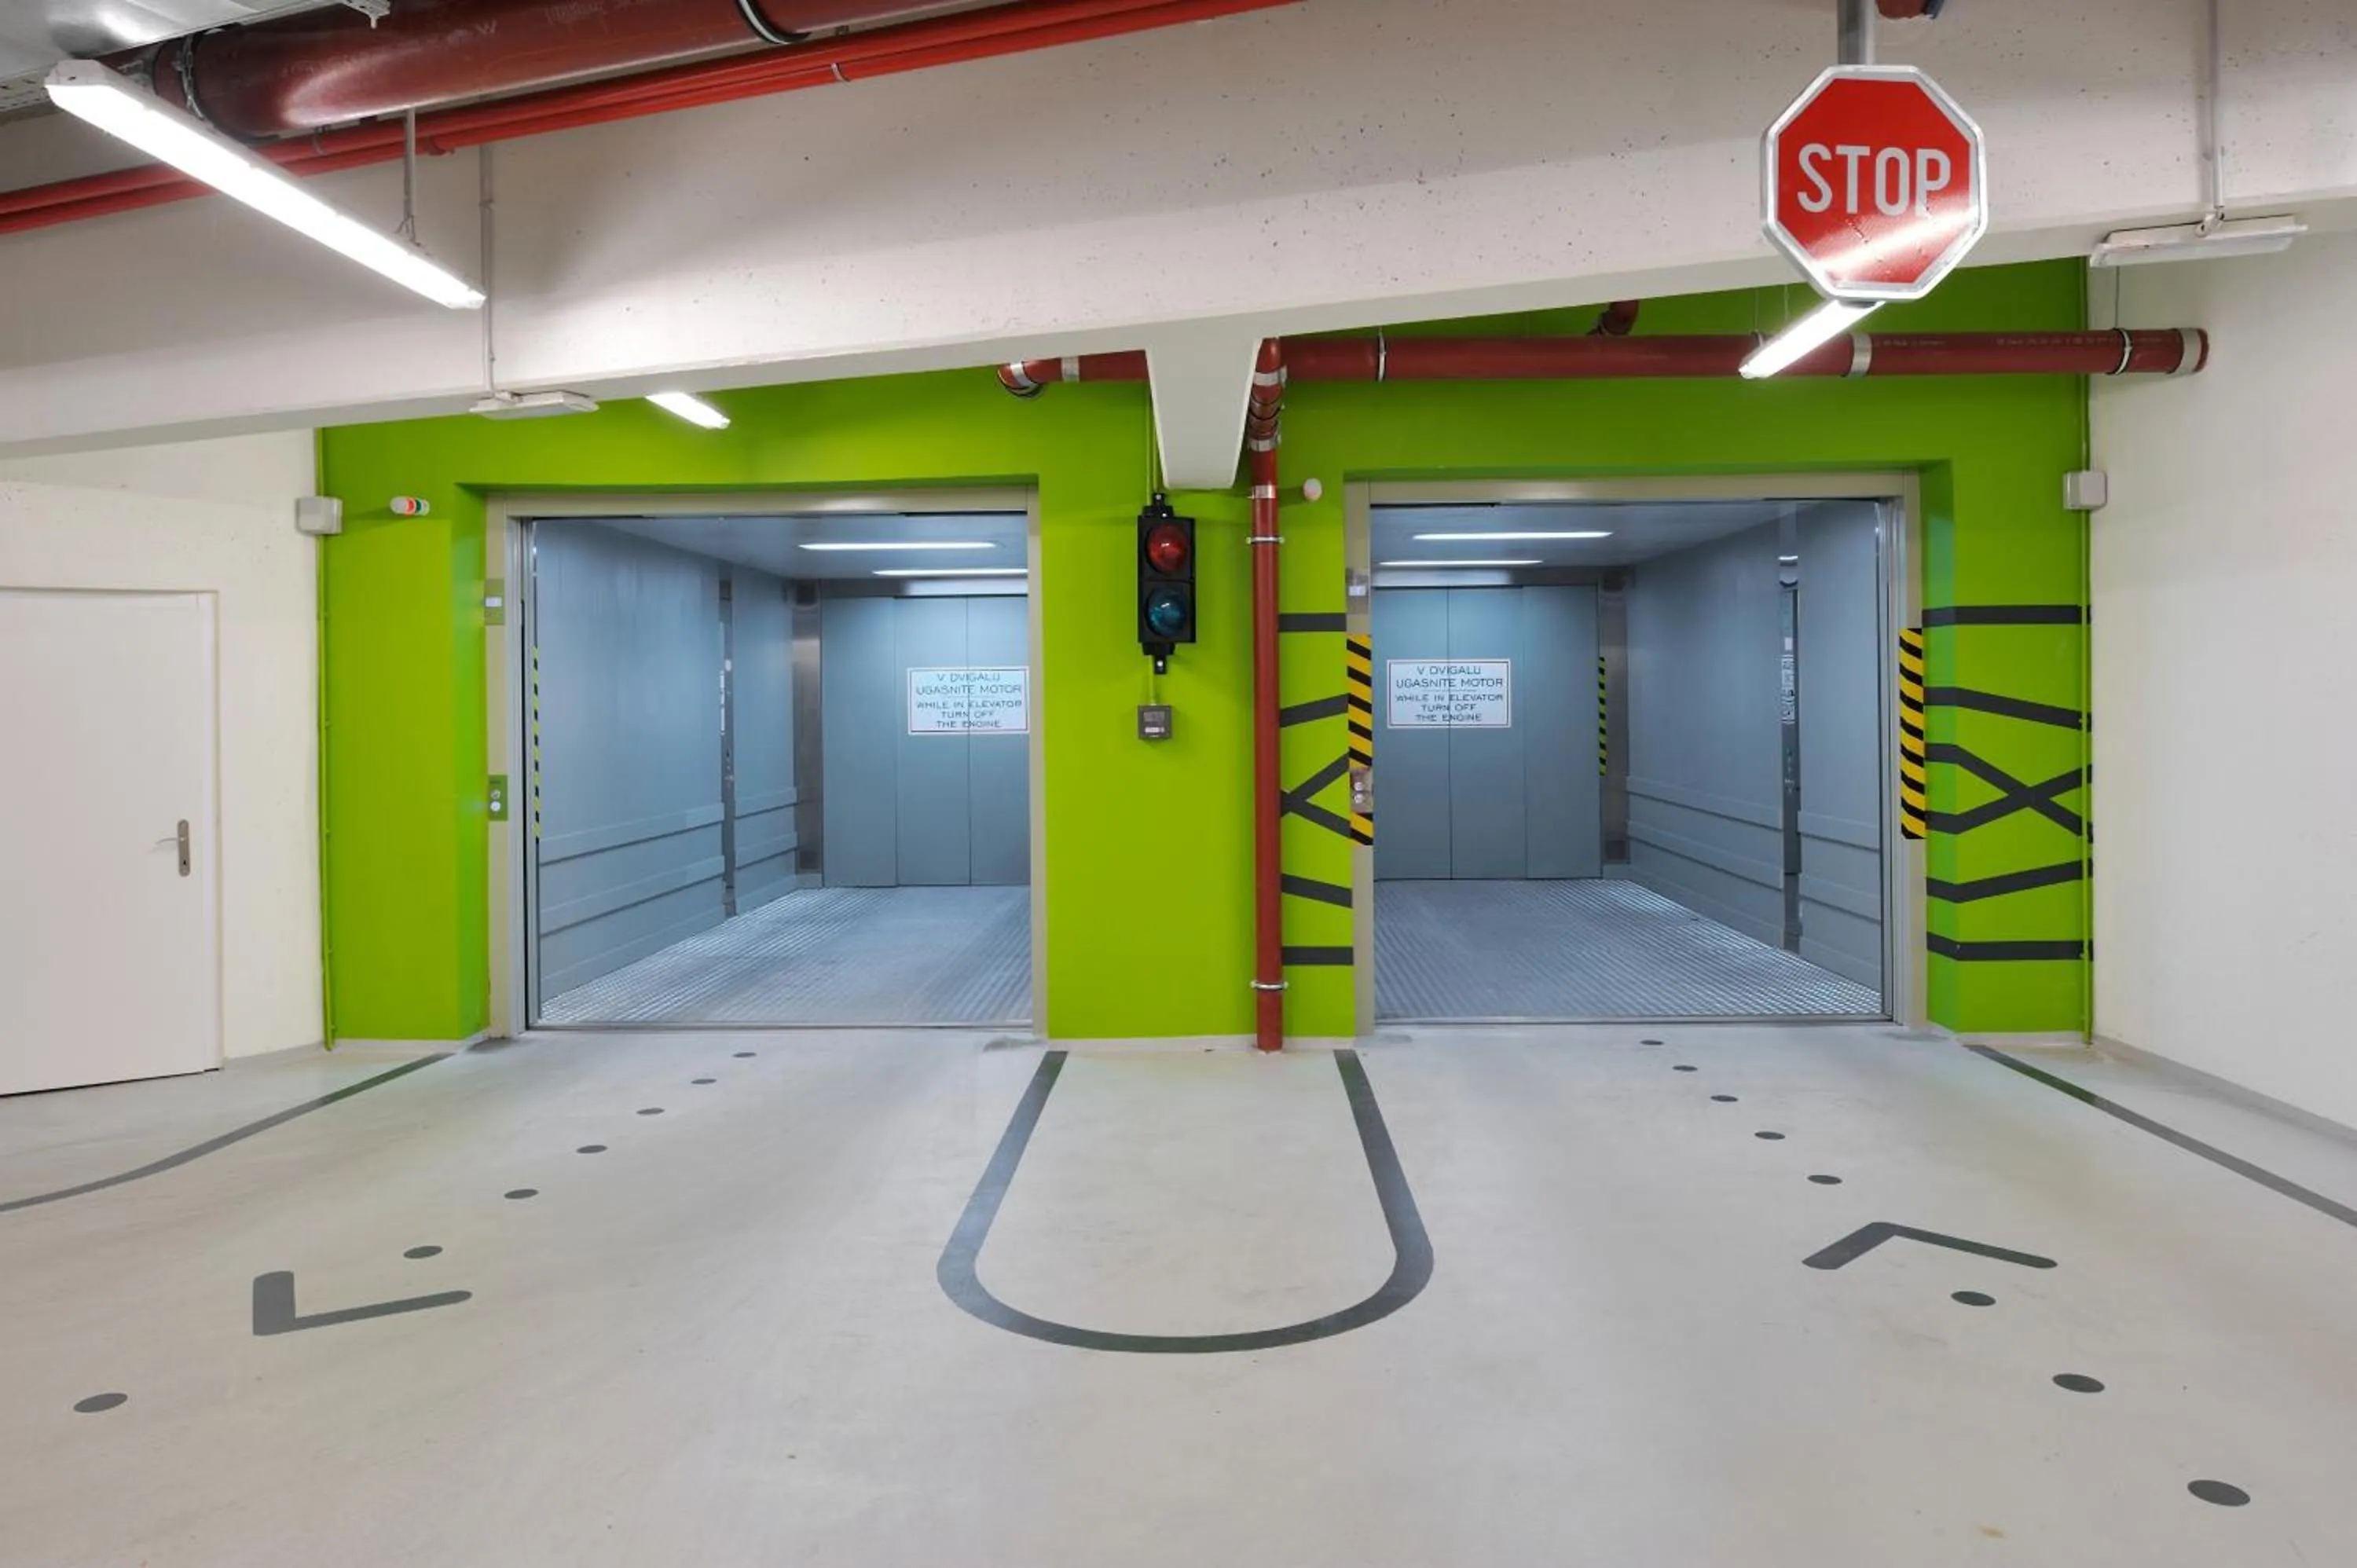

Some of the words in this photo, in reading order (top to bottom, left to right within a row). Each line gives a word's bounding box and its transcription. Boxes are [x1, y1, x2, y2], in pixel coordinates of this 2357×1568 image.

[1797, 142, 1952, 217] STOP
[1417, 665, 1424, 675] V
[1429, 665, 1482, 675] DVIGALU
[937, 672, 944, 682] V
[950, 672, 1001, 682] DVIGALU
[1396, 678, 1456, 688] UGASNITE
[1461, 678, 1503, 687] MOTOR
[915, 684, 975, 695] UGASNITE
[980, 684, 1022, 694] MOTOR
[917, 701, 950, 709] WHILE
[968, 700, 1022, 709] ELEVATOR
[1420, 703, 1450, 712] TURN
[1454, 703, 1477, 712] OFF
[1442, 713, 1483, 722] ENGINE
